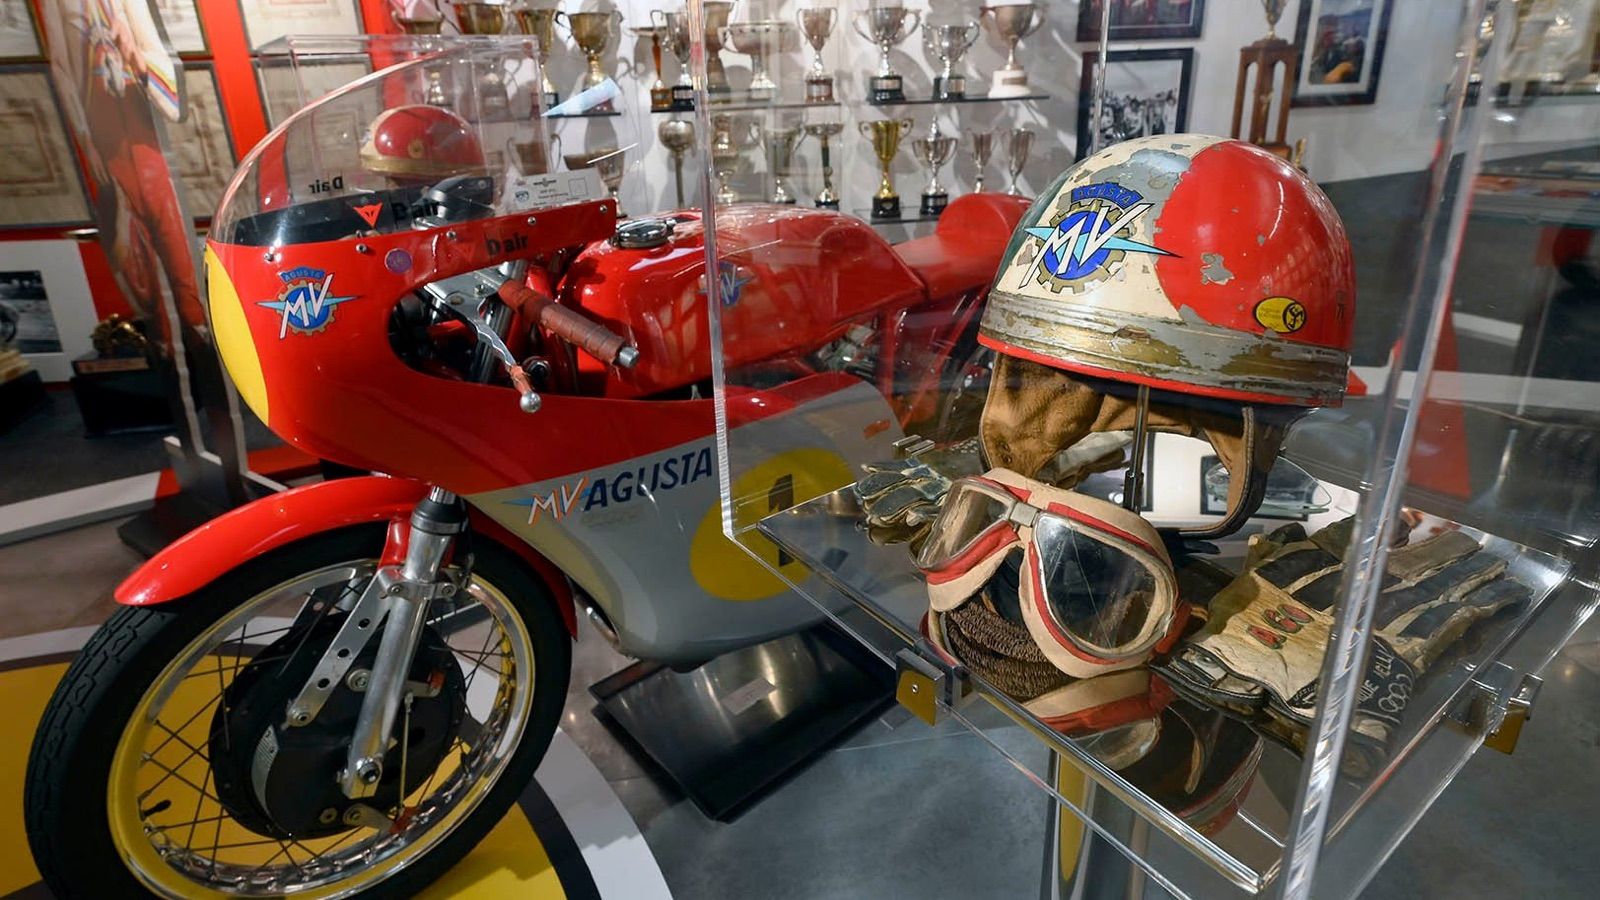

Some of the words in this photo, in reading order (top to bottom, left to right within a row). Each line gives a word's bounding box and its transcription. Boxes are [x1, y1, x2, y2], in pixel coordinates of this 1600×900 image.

[1018, 202, 1156, 290] MV
[279, 273, 334, 339] MV
[527, 476, 588, 527] MV
[584, 447, 713, 511] AGUSTA
